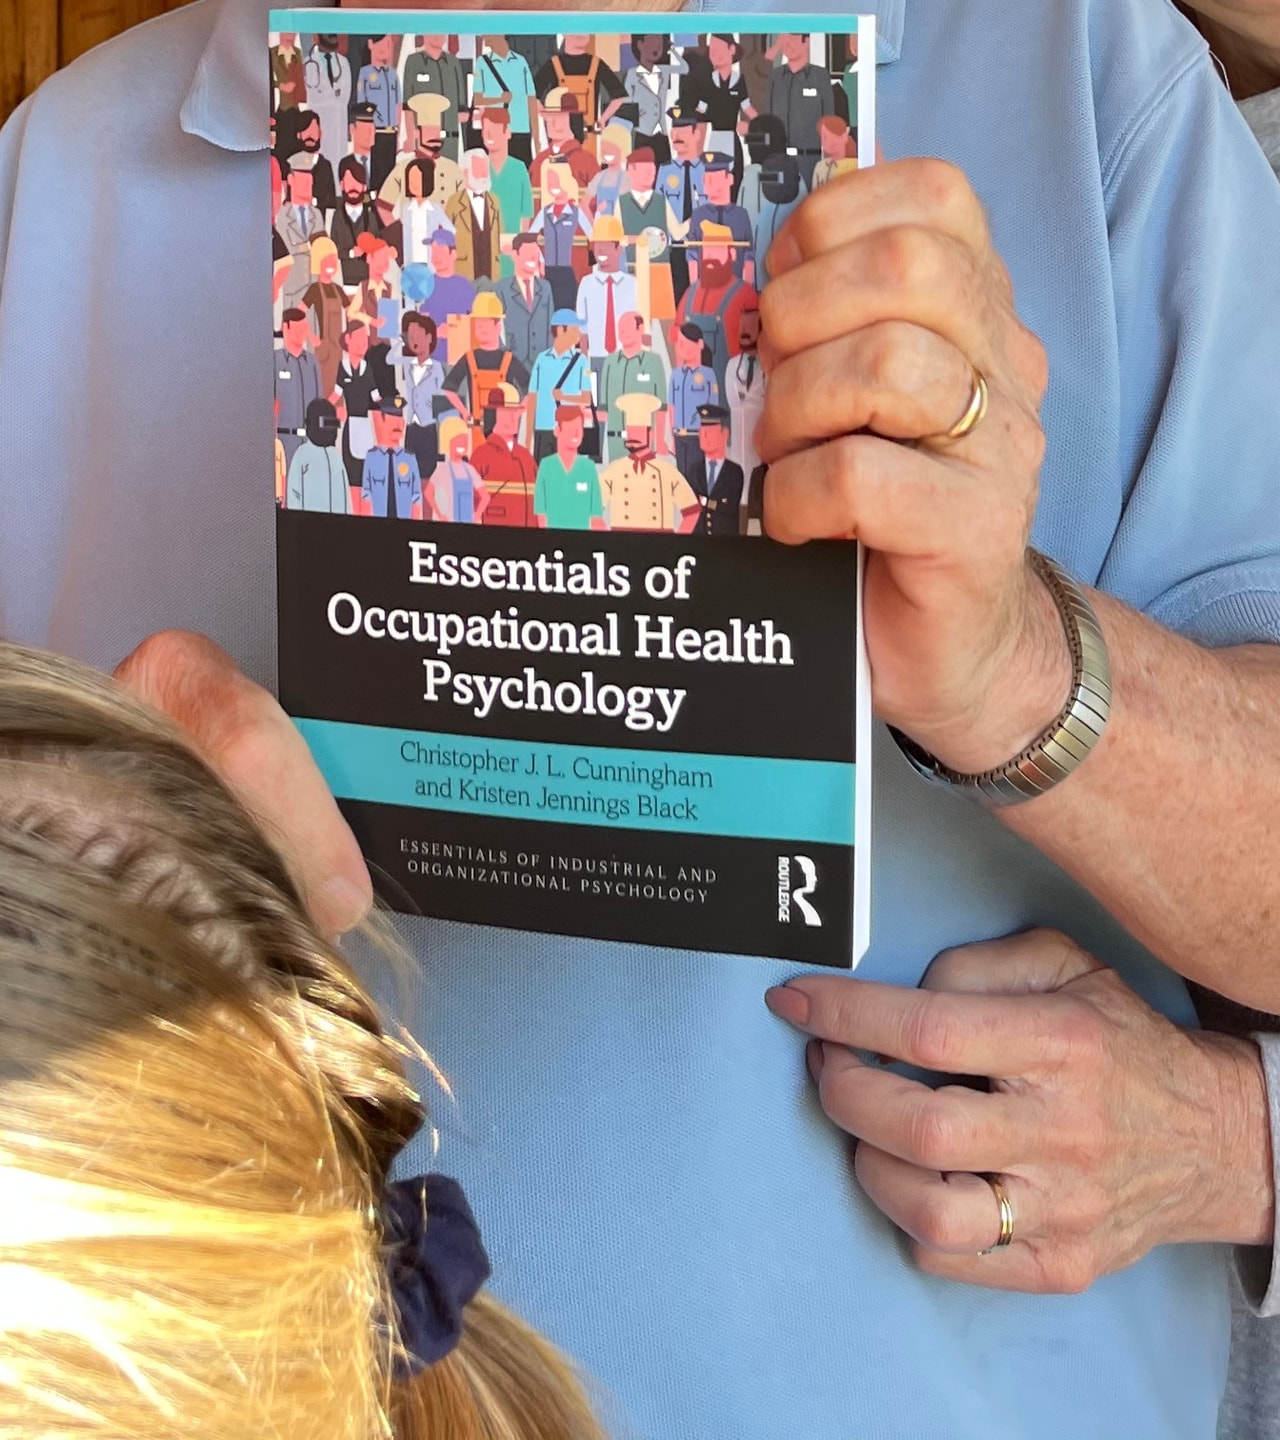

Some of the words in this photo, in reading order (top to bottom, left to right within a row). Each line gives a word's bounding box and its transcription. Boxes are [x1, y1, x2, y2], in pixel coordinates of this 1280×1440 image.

[408, 540, 631, 598] Essentials
[644, 555, 697, 599] of
[327, 592, 622, 657] Occupational
[633, 614, 795, 666] Health
[422, 658, 687, 732] Psychology
[399, 740, 520, 775] Christopher
[524, 752, 540, 776] J.
[546, 754, 566, 779] L.
[572, 756, 714, 791] Cunningham
[414, 776, 453, 800] and
[459, 778, 531, 808] Kristen
[536, 786, 631, 820] Jennings
[637, 794, 699, 821] Black
[399, 838, 509, 864] ESSENTIALS
[516, 852, 541, 868] OF
[550, 855, 668, 881] INDUSTRIAL
[677, 866, 717, 884] AND
[407, 859, 571, 892] ORGANIZATIONAL
[580, 878, 709, 904] PSYCHOLOGY
[777, 856, 791, 923] ROUTLEDGE
